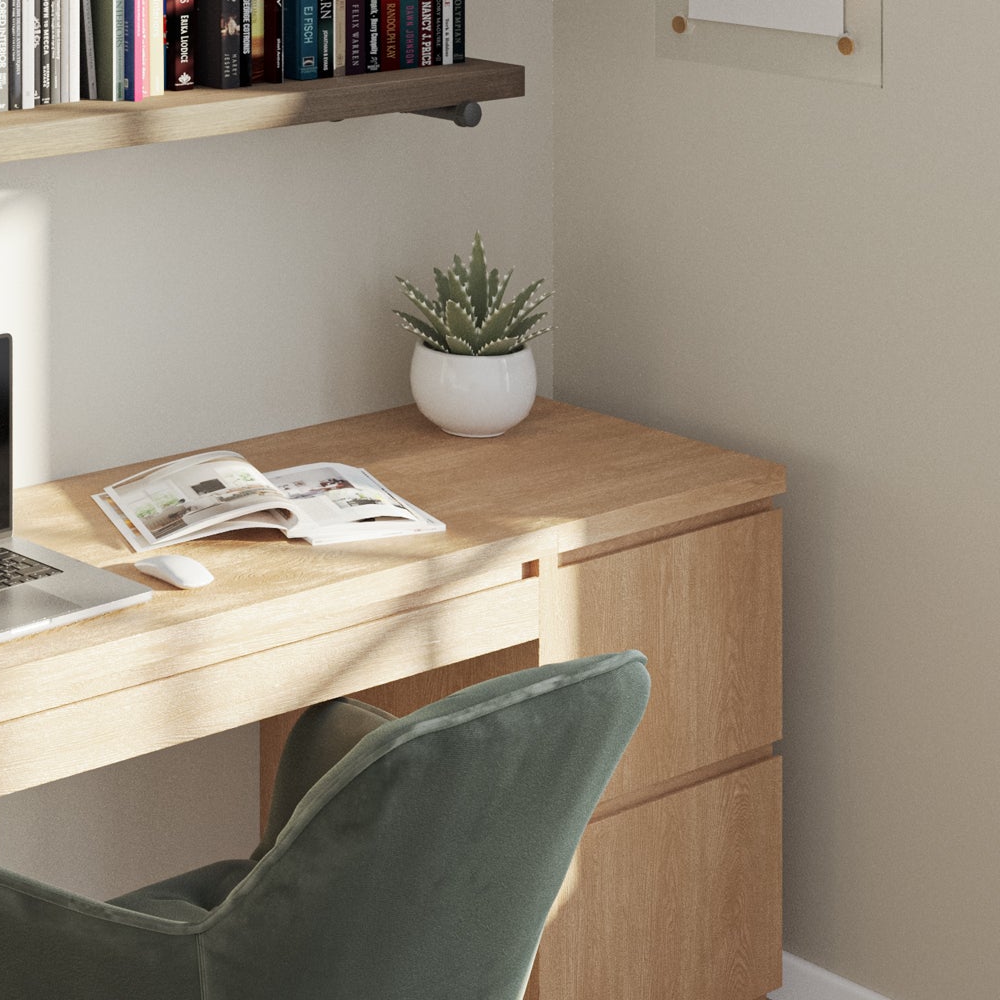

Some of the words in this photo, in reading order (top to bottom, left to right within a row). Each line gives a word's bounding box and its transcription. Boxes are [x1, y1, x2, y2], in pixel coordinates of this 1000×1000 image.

[303, 6, 313, 16] EJ
[351, 4, 360, 28] FELIX
[386, 3, 395, 43] RANDOLPH
[406, 5, 414, 26] DAWN
[422, 1, 431, 31] NANCY
[180, 14, 189, 35] ERIKA
[303, 18, 313, 44] FISCH
[180, 36, 189, 63] LIODICE
[351, 31, 360, 66] WARREN
[386, 45, 395, 59] KAY
[406, 29, 414, 64] JOHNSON
[422, 41, 431, 66] PRICE
